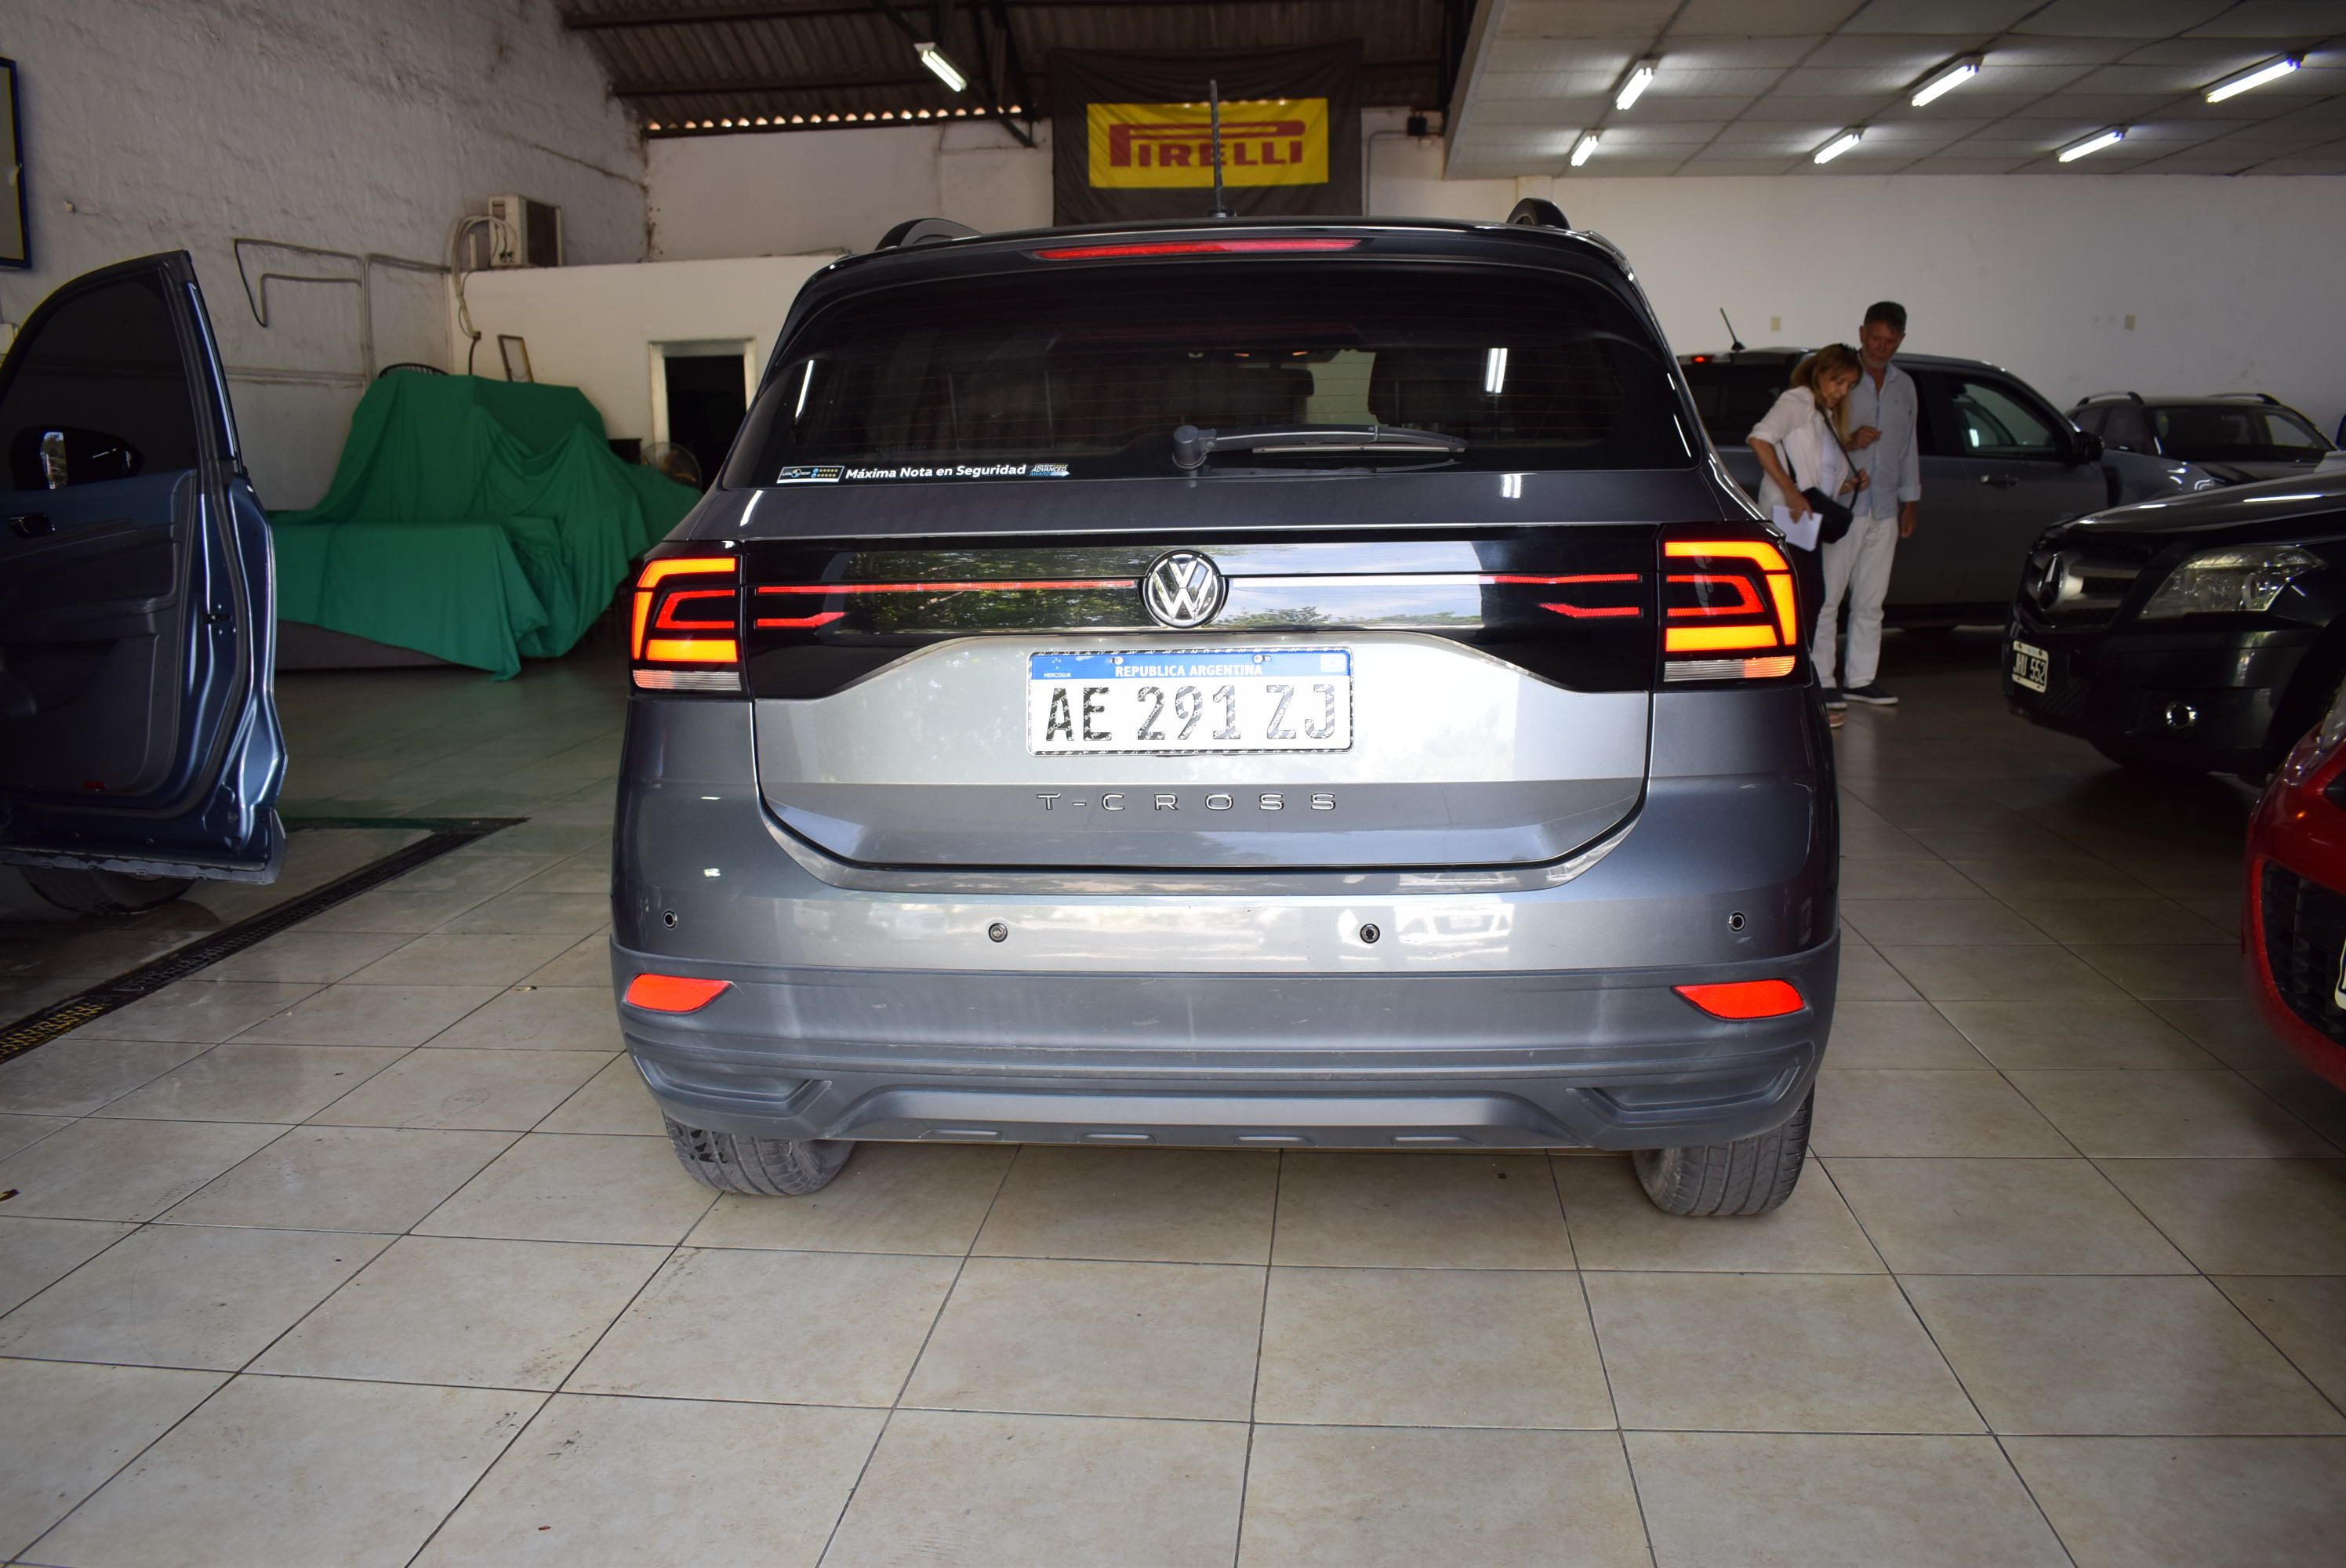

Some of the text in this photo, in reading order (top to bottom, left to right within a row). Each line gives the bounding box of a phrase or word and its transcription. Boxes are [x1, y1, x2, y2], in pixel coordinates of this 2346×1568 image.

[1109, 120, 1306, 167] PIRELLI
[845, 465, 1027, 479] Máxima Nota en Seguridad
[1114, 663, 1263, 677] REPUBLICA ARGENTINA
[2029, 658, 2046, 684] 552
[1045, 684, 1335, 742] AE 291 ZJ
[1036, 792, 1336, 811] T-CROSS
